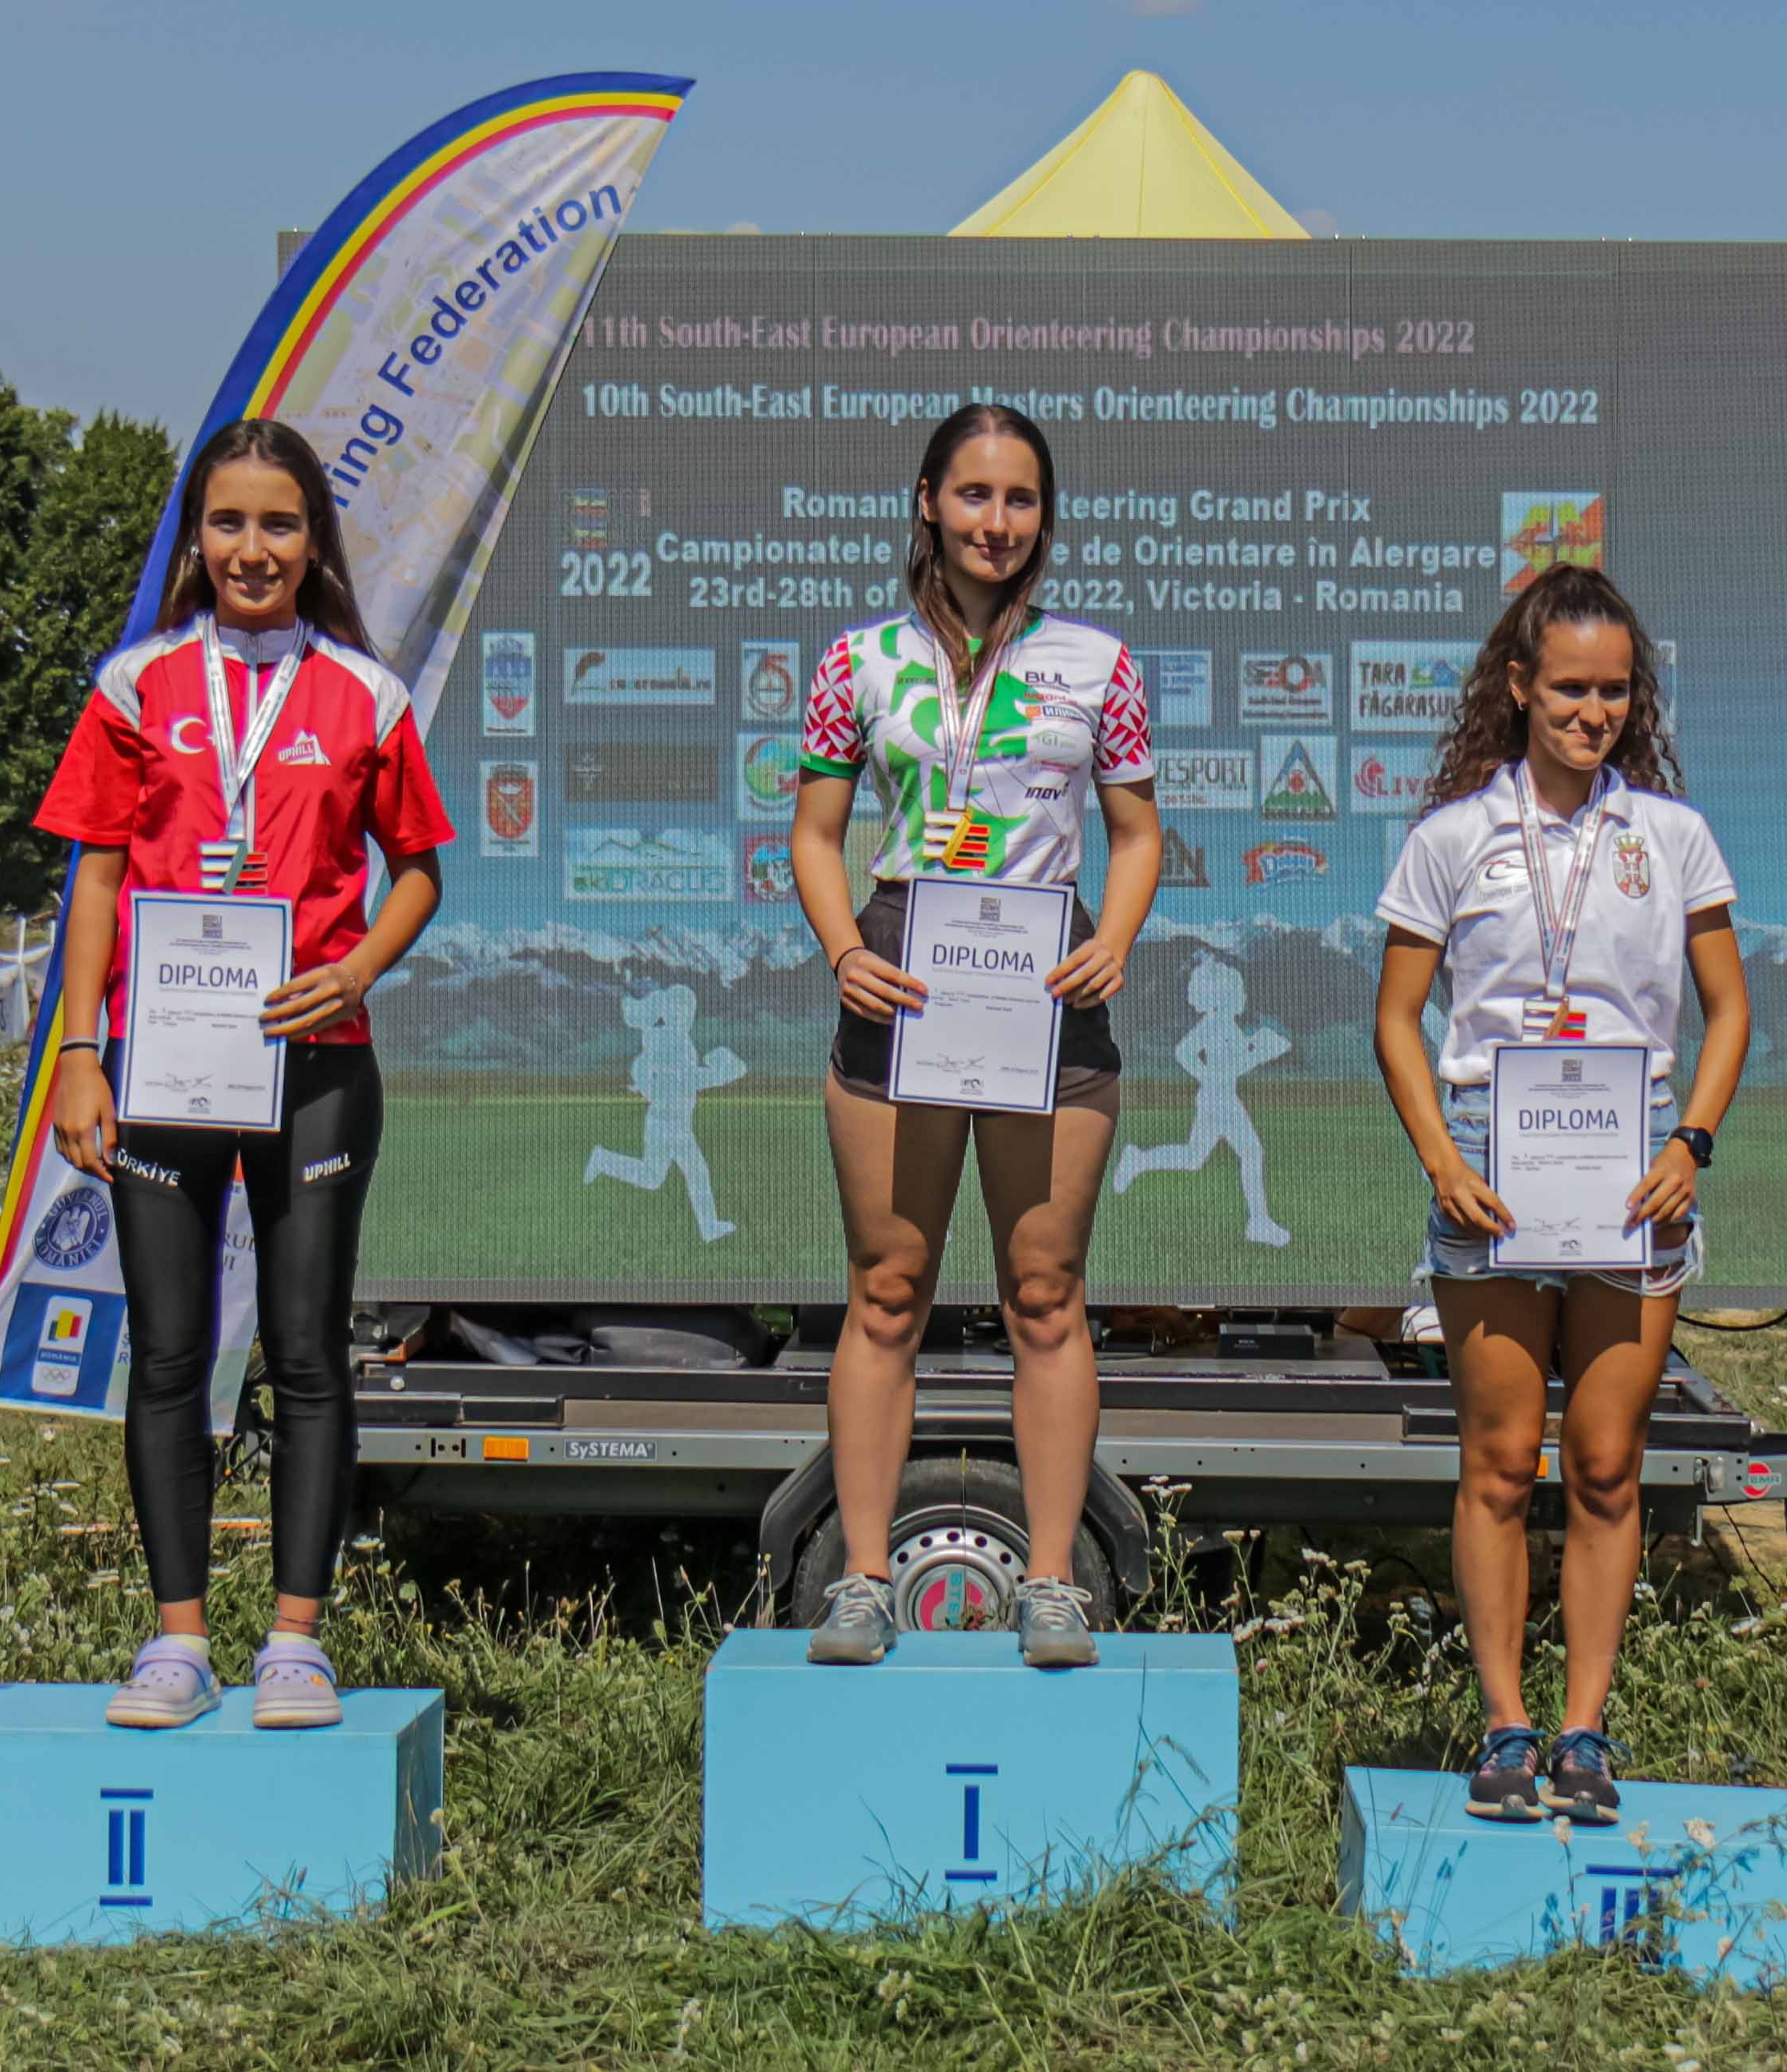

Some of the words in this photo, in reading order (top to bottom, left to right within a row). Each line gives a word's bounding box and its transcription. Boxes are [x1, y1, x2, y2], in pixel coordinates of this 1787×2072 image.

[377, 183, 622, 398] Federation
[582, 316, 647, 349] 11th
[658, 316, 811, 350] South-East
[823, 318, 960, 357] European
[971, 318, 1152, 360] Orienteering
[1164, 319, 1386, 360] Championships
[1396, 321, 1475, 354] 2022
[583, 382, 650, 417] 10th
[658, 383, 812, 419] South-East
[823, 385, 960, 425] European
[1095, 385, 1278, 428] Orienteering
[1286, 387, 1509, 429] Championships
[1520, 390, 1599, 424] 2022
[783, 487, 911, 519] Romani
[1191, 490, 1292, 522] Grand
[1306, 491, 1371, 523] Prix
[656, 532, 891, 569] Campionatele
[1082, 536, 1121, 566] de
[1134, 536, 1296, 568] Orientare
[1308, 537, 1338, 568] în
[1350, 537, 1495, 577] Alergare
[561, 551, 652, 597] 2022
[689, 577, 853, 608] 23rd-28th
[865, 577, 898, 608] of
[1043, 580, 1134, 615] 2022,
[1146, 580, 1282, 613] Victoria
[1316, 582, 1463, 614] Romania
[1025, 670, 1071, 689] BUL
[159, 963, 259, 990] DIPLOMA
[932, 943, 1035, 974] DIPLOMA
[1519, 1108, 1620, 1130] DIPLOMA
[117, 1147, 181, 1187] ÜRKİYE
[304, 1153, 351, 1183] UPHILL
